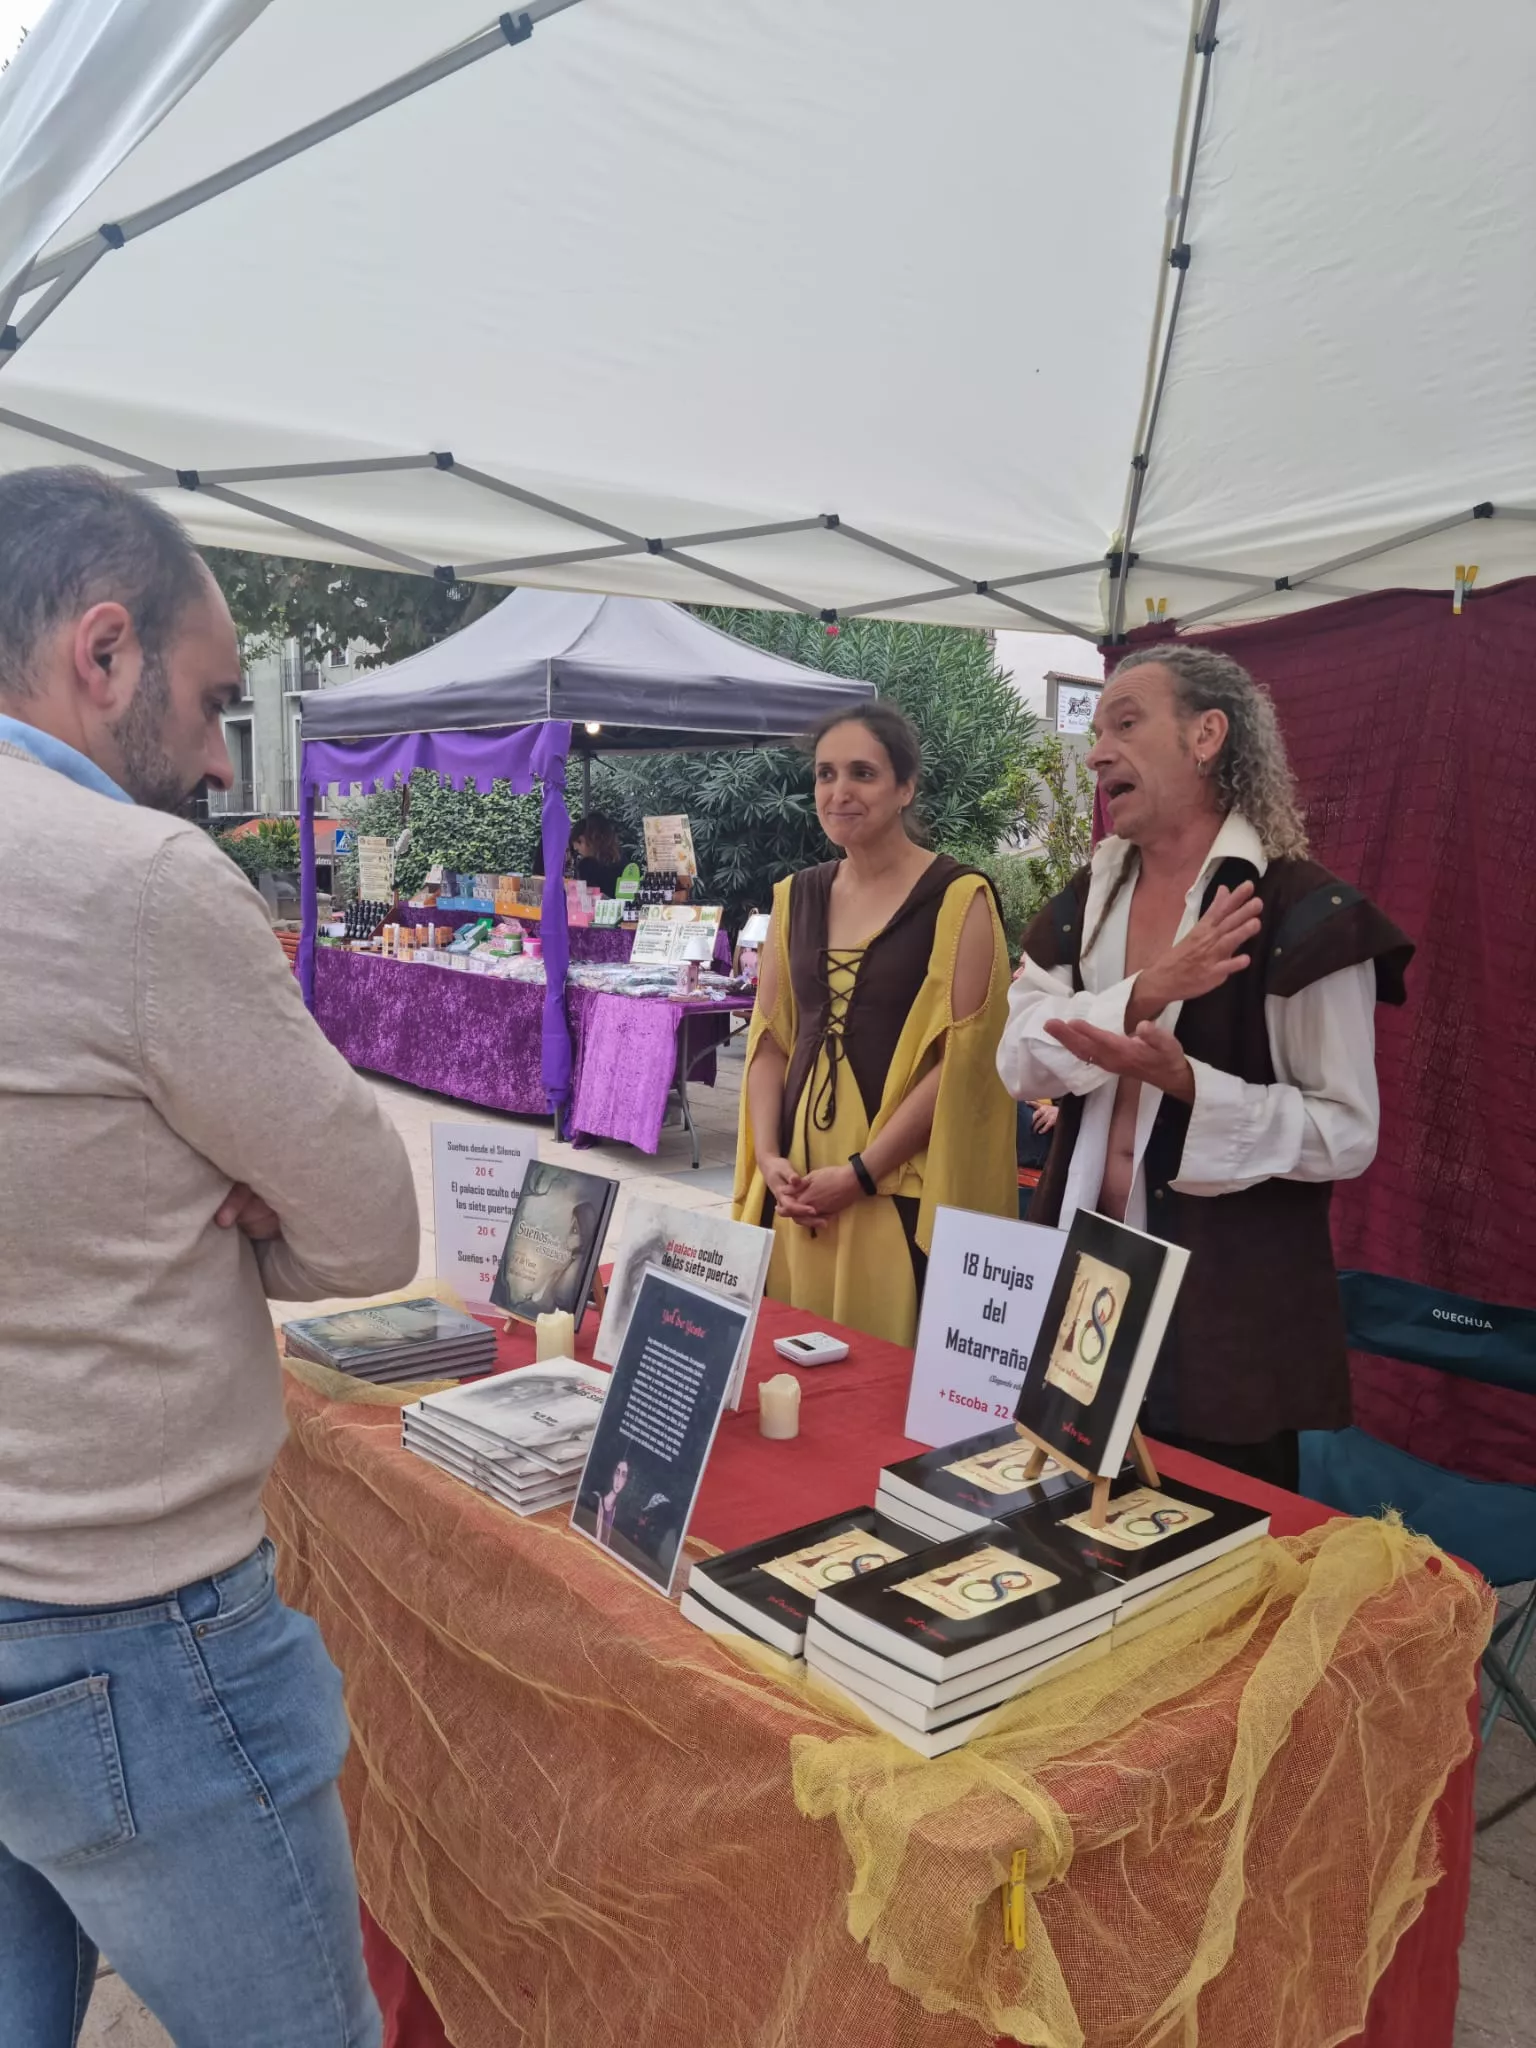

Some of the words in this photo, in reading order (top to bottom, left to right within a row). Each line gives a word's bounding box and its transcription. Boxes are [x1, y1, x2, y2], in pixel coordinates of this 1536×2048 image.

[471, 1144, 488, 1154] desde
[490, 1145, 495, 1154] el
[497, 1145, 521, 1157] Silencio
[475, 1166, 486, 1176] 20
[488, 1168, 494, 1177] €
[451, 1181, 458, 1193] El
[460, 1183, 485, 1195] palacio
[487, 1187, 509, 1198] oculto
[511, 1188, 520, 1199] de
[456, 1199, 467, 1209] las
[468, 1201, 486, 1212] siete
[488, 1204, 515, 1216] puertas
[477, 1226, 488, 1236] 20
[490, 1227, 496, 1237] €
[517, 1221, 549, 1244] Sueños
[457, 1250, 484, 1264] Sueños
[666, 1239, 674, 1251] el
[673, 1243, 697, 1258] palacio
[698, 1249, 724, 1266] oculto
[479, 1272, 490, 1283] 35
[661, 1252, 672, 1266] de
[671, 1254, 685, 1270] las
[684, 1261, 706, 1277] siete
[705, 1268, 738, 1287] puertas
[962, 1252, 980, 1277] 18
[983, 1256, 1034, 1291] brujas
[982, 1298, 1007, 1324] del
[1432, 1308, 1493, 1330] QUECHUA
[945, 1327, 1029, 1372] Matarraña
[948, 1390, 988, 1413] Escoba
[994, 1404, 1009, 1420] 22
